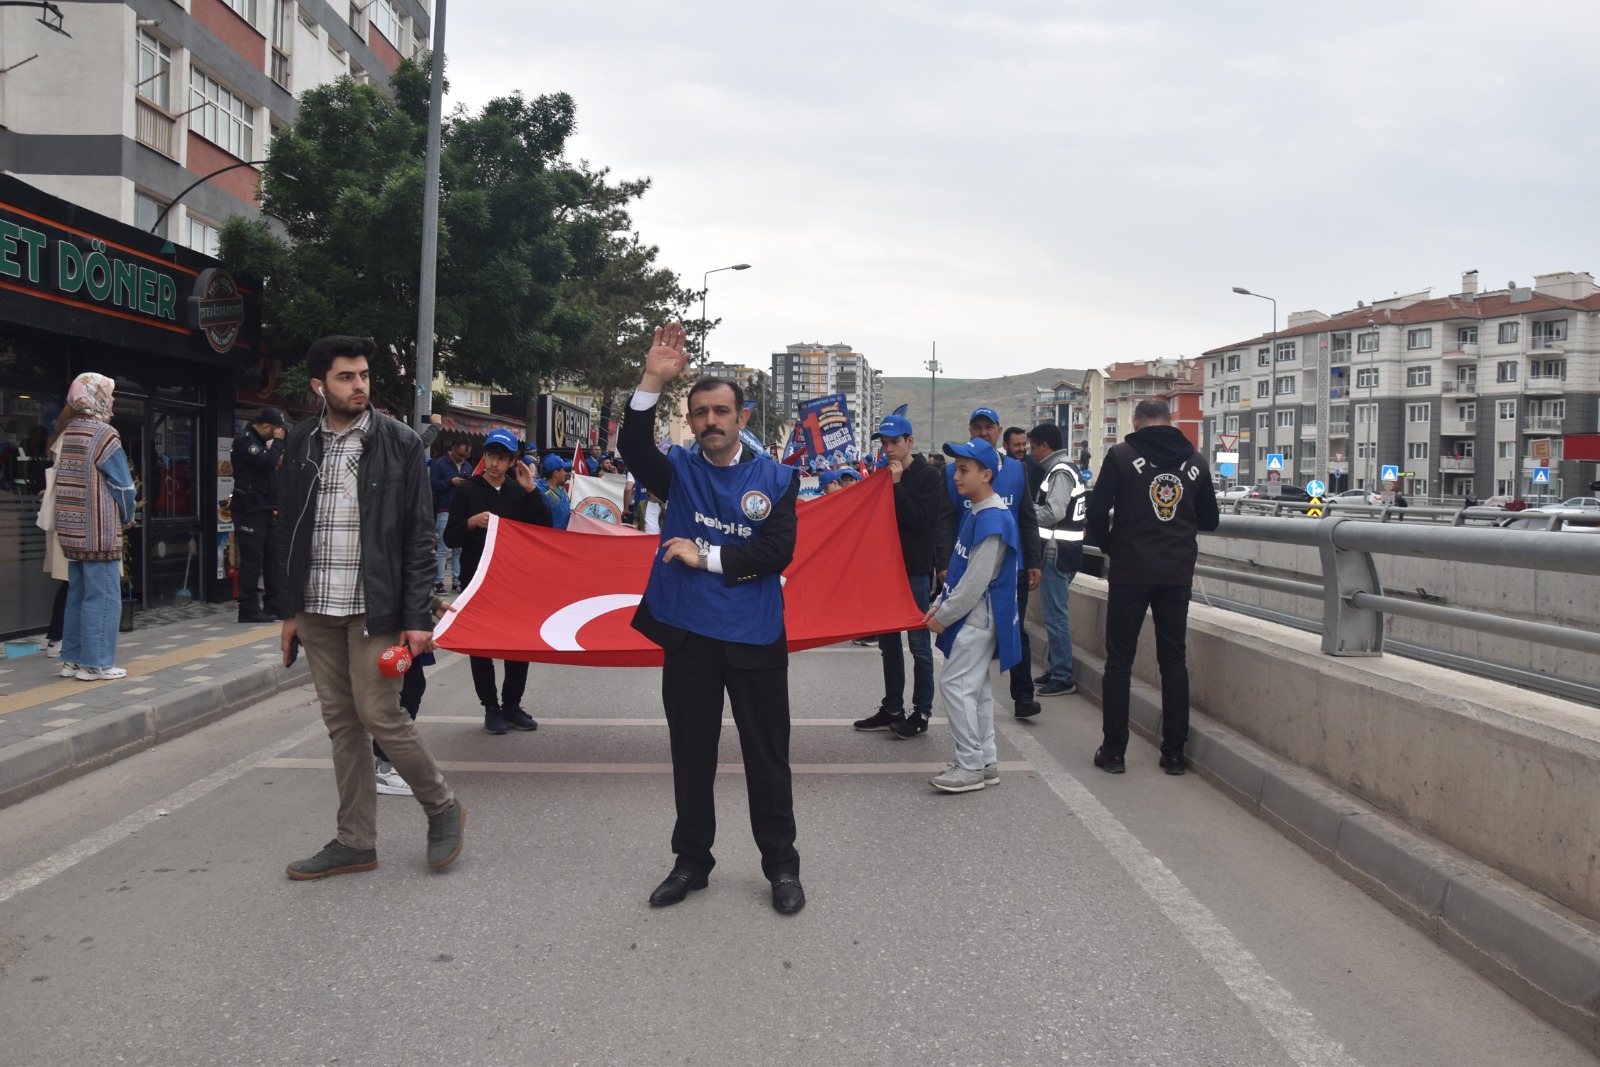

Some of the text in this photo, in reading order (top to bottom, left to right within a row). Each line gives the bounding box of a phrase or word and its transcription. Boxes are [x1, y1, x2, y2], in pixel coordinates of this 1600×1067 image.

[58, 238, 177, 320] DÖNER
[565, 409, 589, 439] REYHAN
[802, 412, 825, 455] 1
